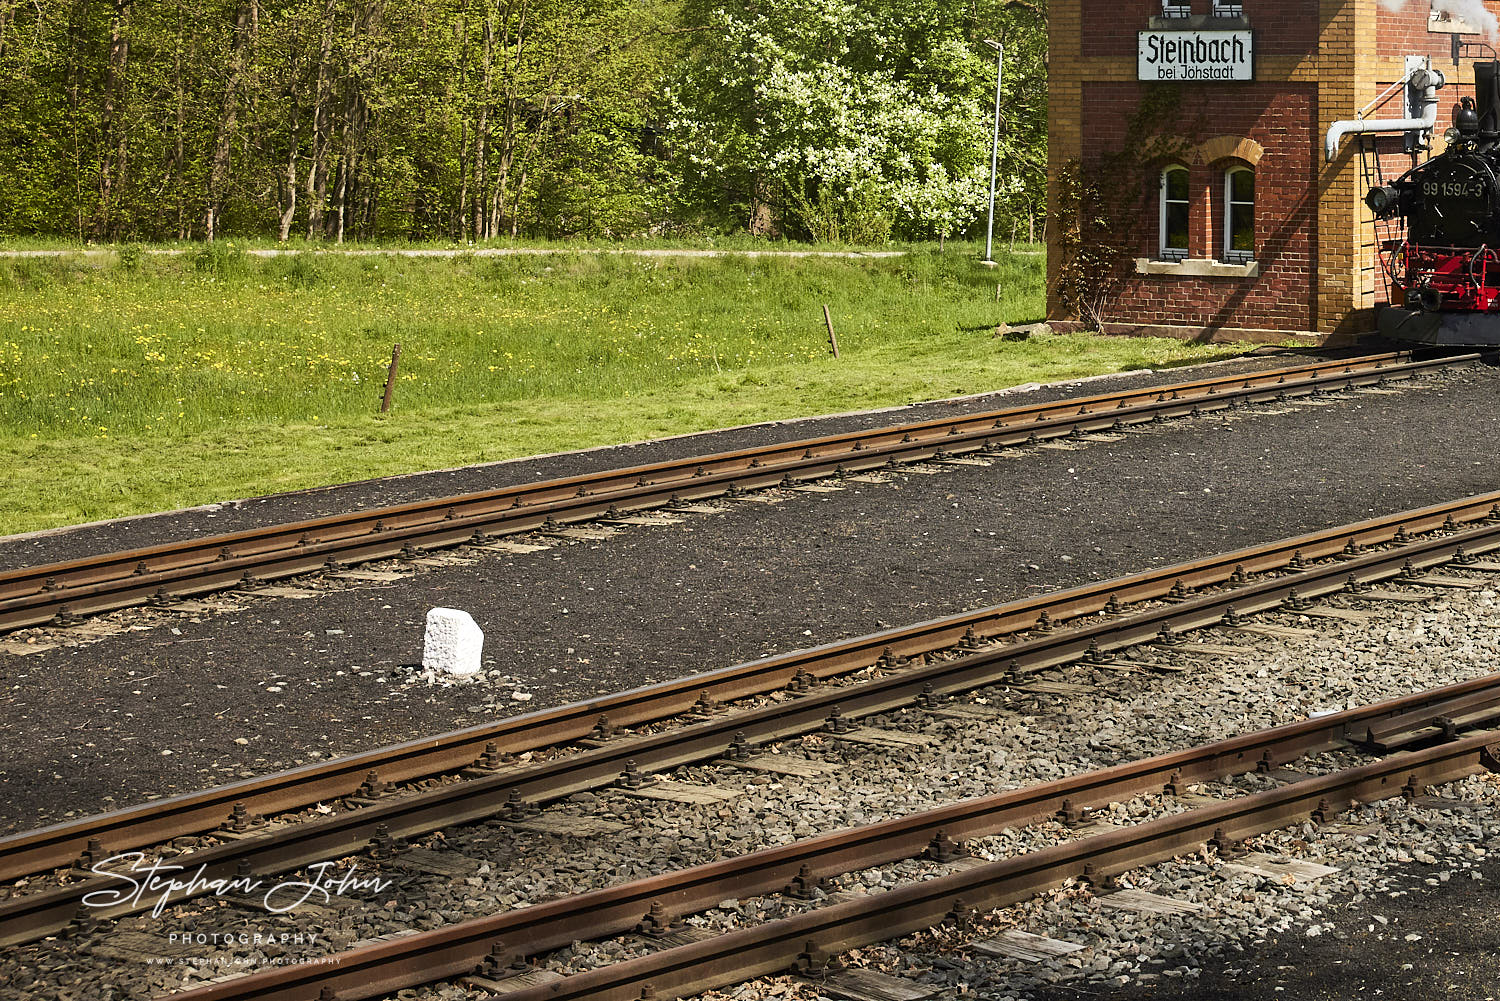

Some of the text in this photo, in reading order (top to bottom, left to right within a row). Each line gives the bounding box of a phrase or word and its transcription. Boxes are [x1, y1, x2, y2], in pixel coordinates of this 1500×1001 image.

[1146, 34, 1245, 64] Steinbach
[1158, 65, 1234, 79] bei Jöhstadt
[1423, 182, 1483, 197] 99 1594-3
